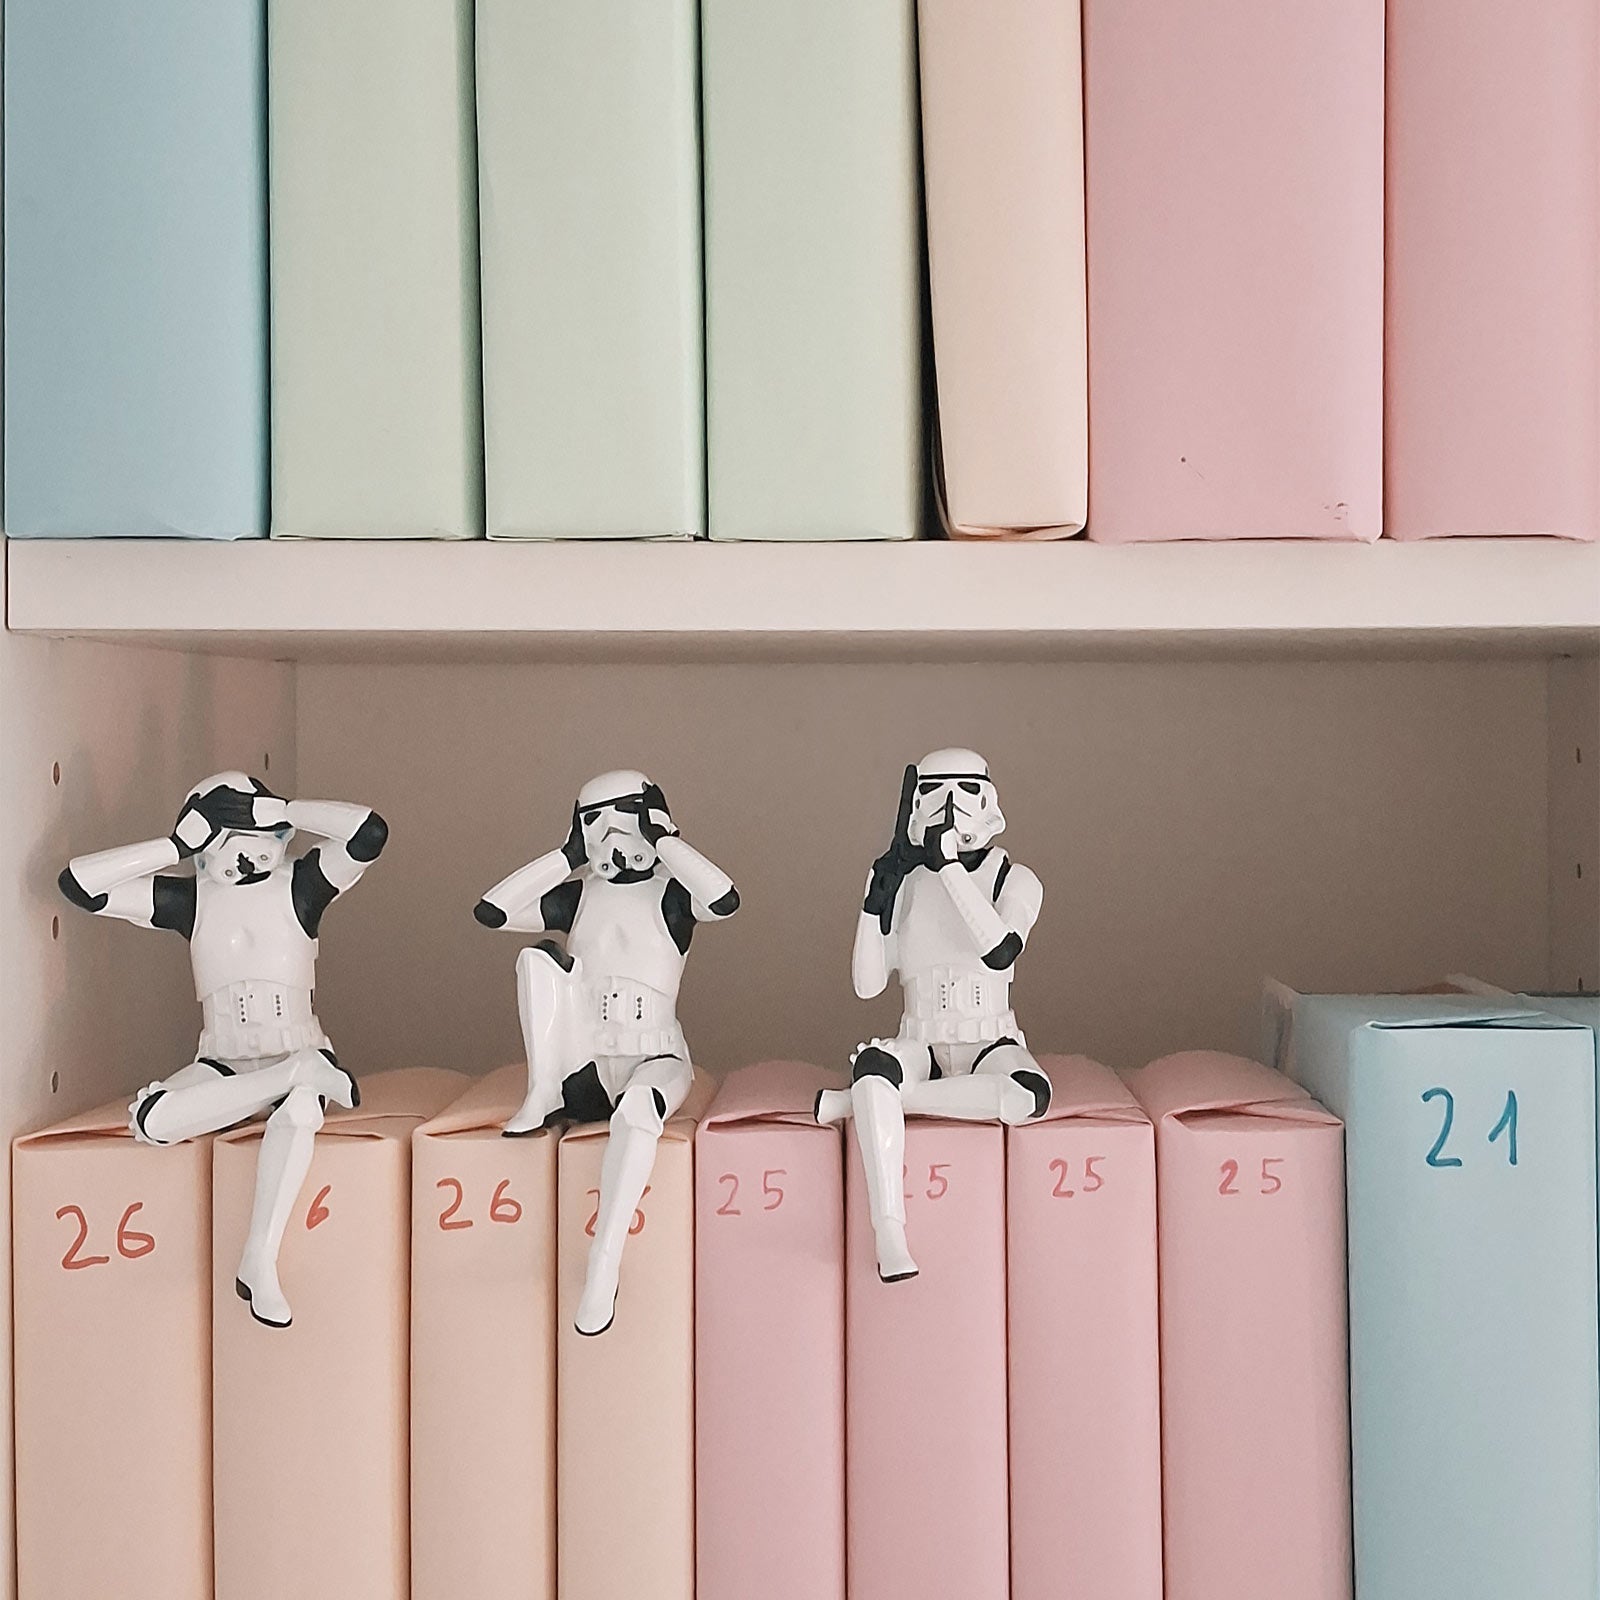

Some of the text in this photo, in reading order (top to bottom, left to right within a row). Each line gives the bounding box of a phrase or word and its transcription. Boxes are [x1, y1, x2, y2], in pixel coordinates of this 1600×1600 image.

[1420, 1086, 1519, 1168] 21
[716, 1169, 787, 1216] 25
[1049, 1156, 1105, 1199] 25
[1218, 1158, 1284, 1196] 25
[435, 1177, 523, 1232] 26
[55, 1201, 156, 1271] 26
